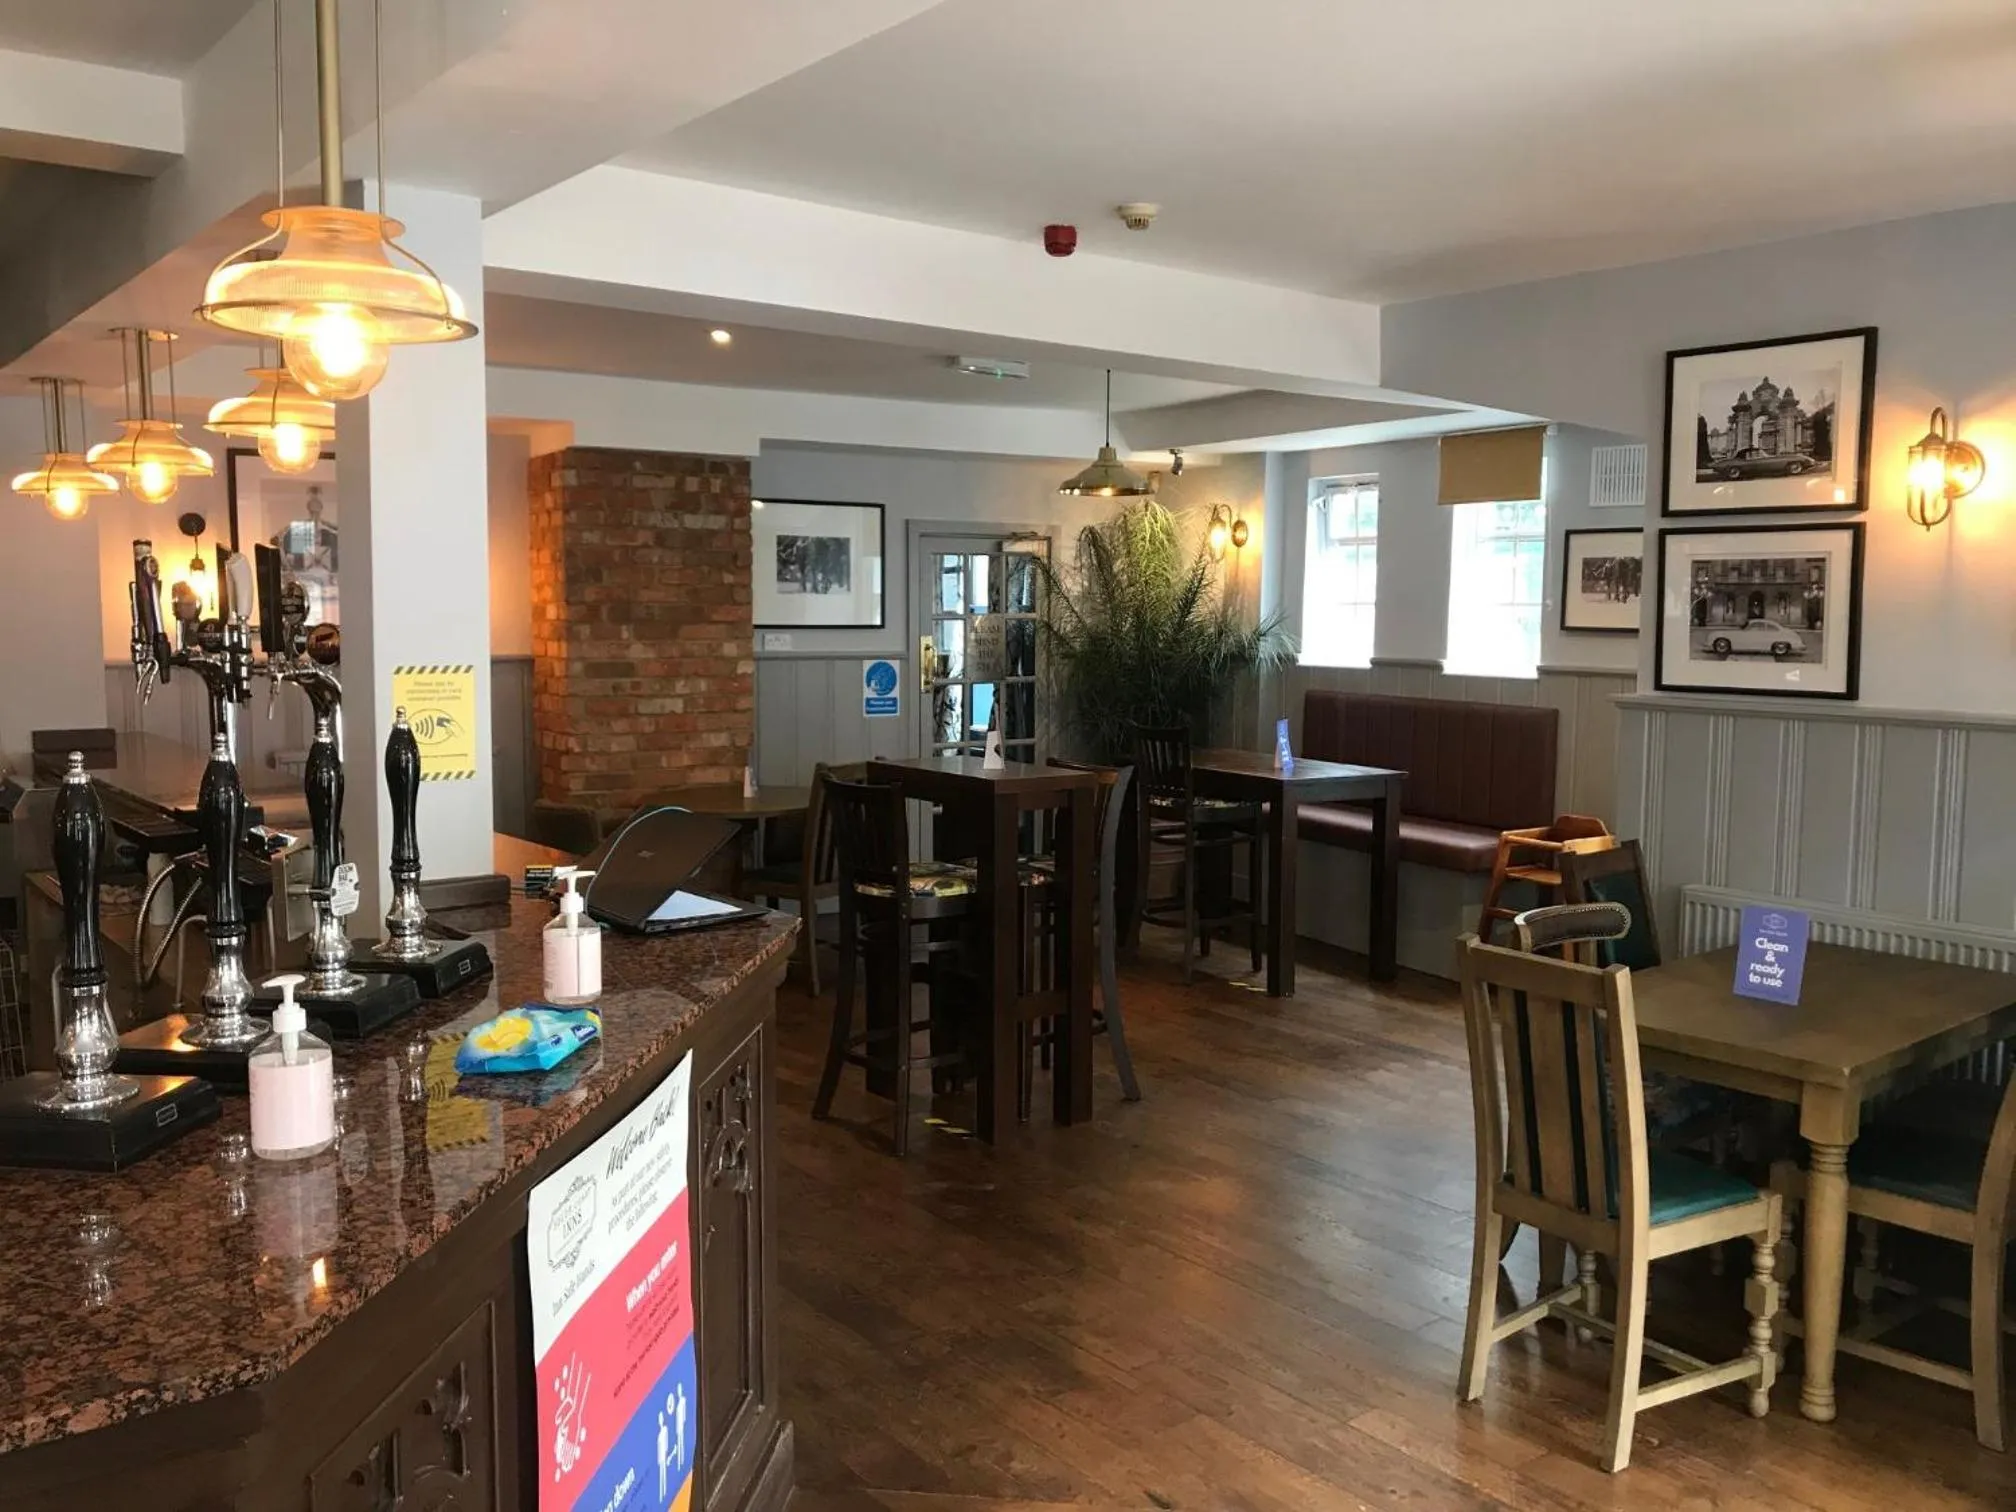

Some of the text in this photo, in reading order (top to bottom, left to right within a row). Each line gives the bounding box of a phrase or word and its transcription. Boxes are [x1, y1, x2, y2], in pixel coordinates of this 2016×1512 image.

[1754, 936, 1789, 953] Clean
[1764, 951, 1776, 962] &
[1749, 962, 1785, 978] ready
[1749, 973, 1783, 987] to use
[606, 1126, 648, 1180] Welcome
[626, 1279, 647, 1313] When
[647, 1262, 661, 1292] you
